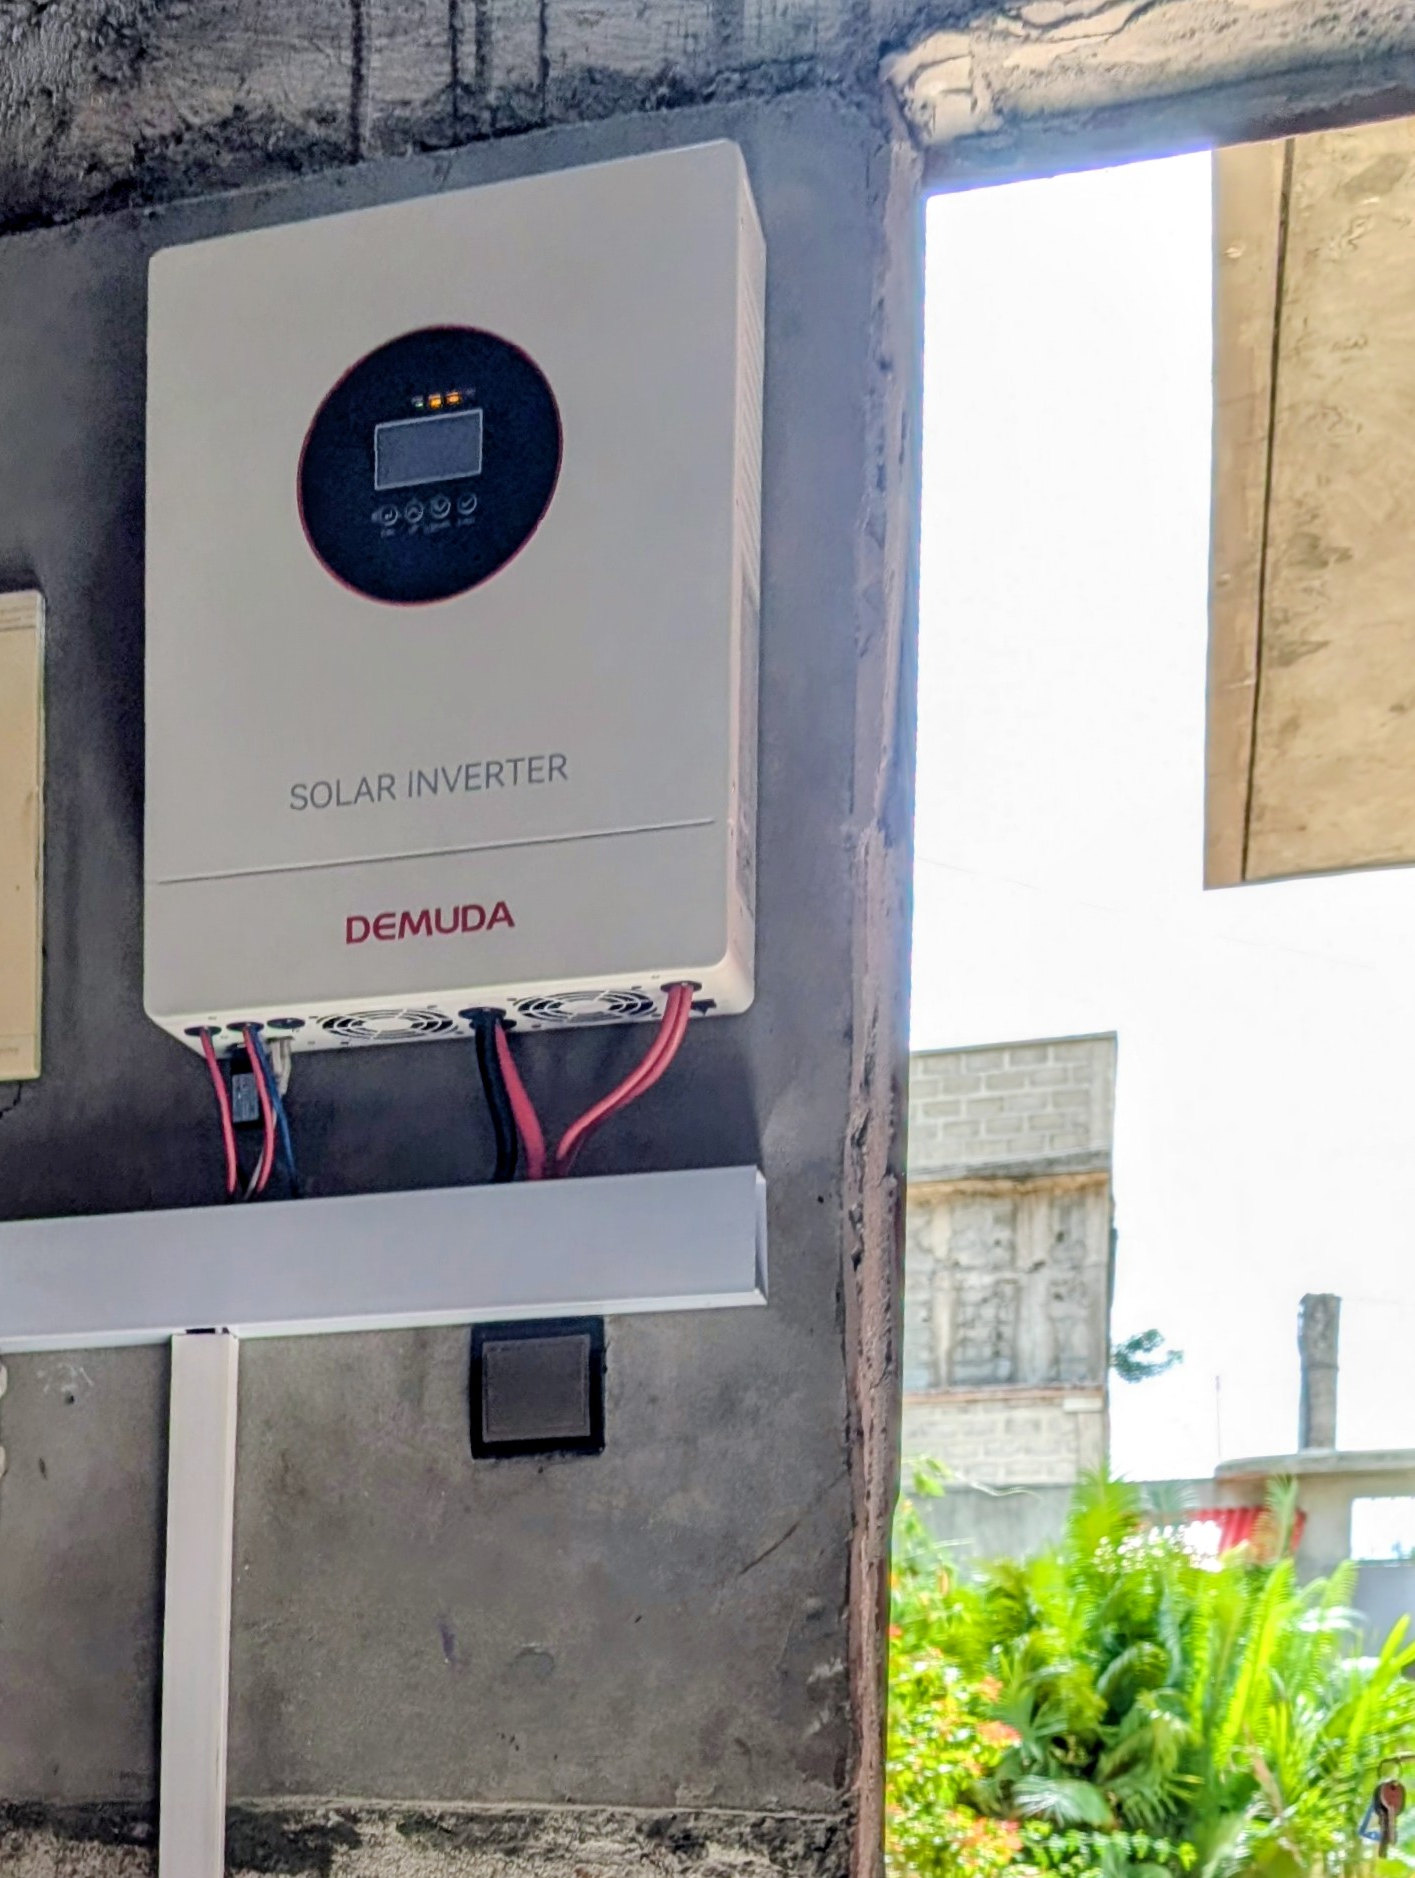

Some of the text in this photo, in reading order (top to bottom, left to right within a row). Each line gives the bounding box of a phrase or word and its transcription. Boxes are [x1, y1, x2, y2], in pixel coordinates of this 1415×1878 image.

[289, 752, 569, 811] SOLAR INVERTER
[345, 900, 516, 945] DEMUDA
